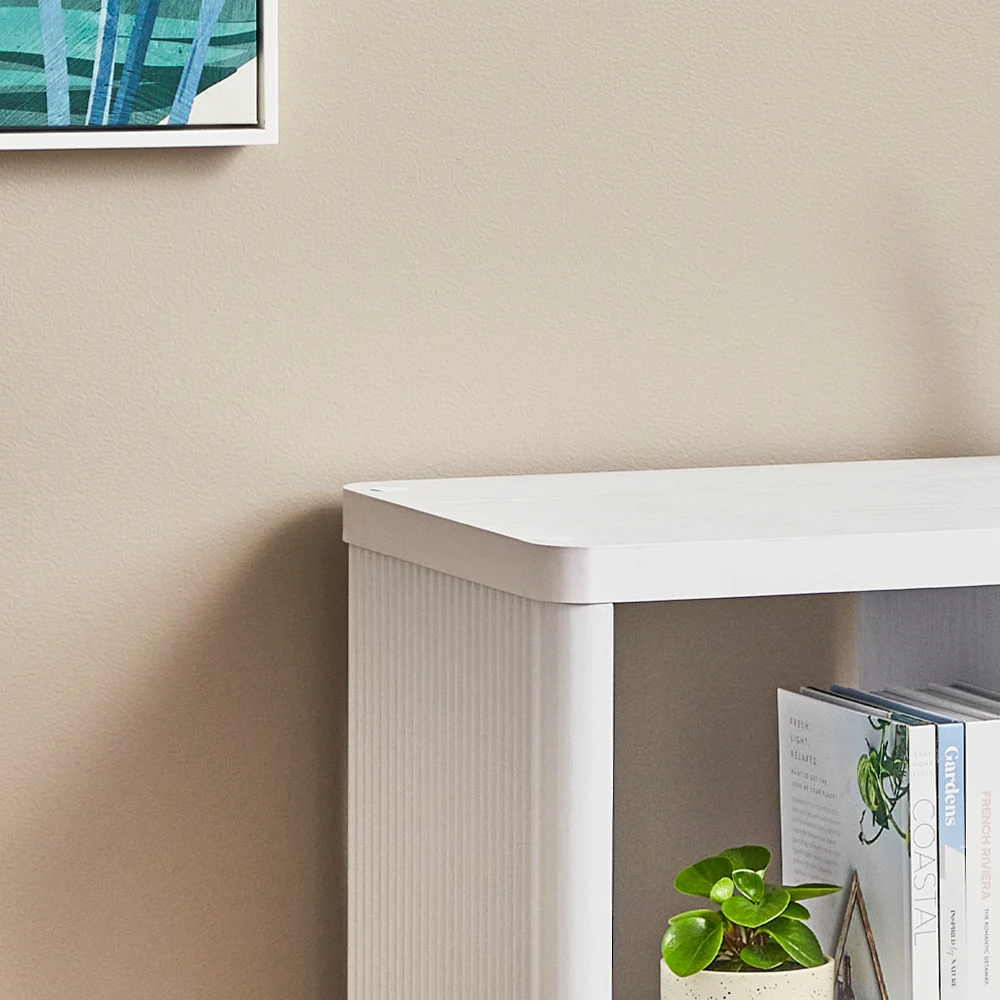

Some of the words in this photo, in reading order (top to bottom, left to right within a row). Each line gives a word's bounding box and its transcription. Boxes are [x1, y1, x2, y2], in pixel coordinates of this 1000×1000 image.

[790, 750, 820, 767] RELAXED.
[944, 745, 960, 827] Gardens
[981, 790, 992, 845] FRENCH
[912, 798, 937, 946] COASTAL
[981, 847, 992, 901] RIVIERA
